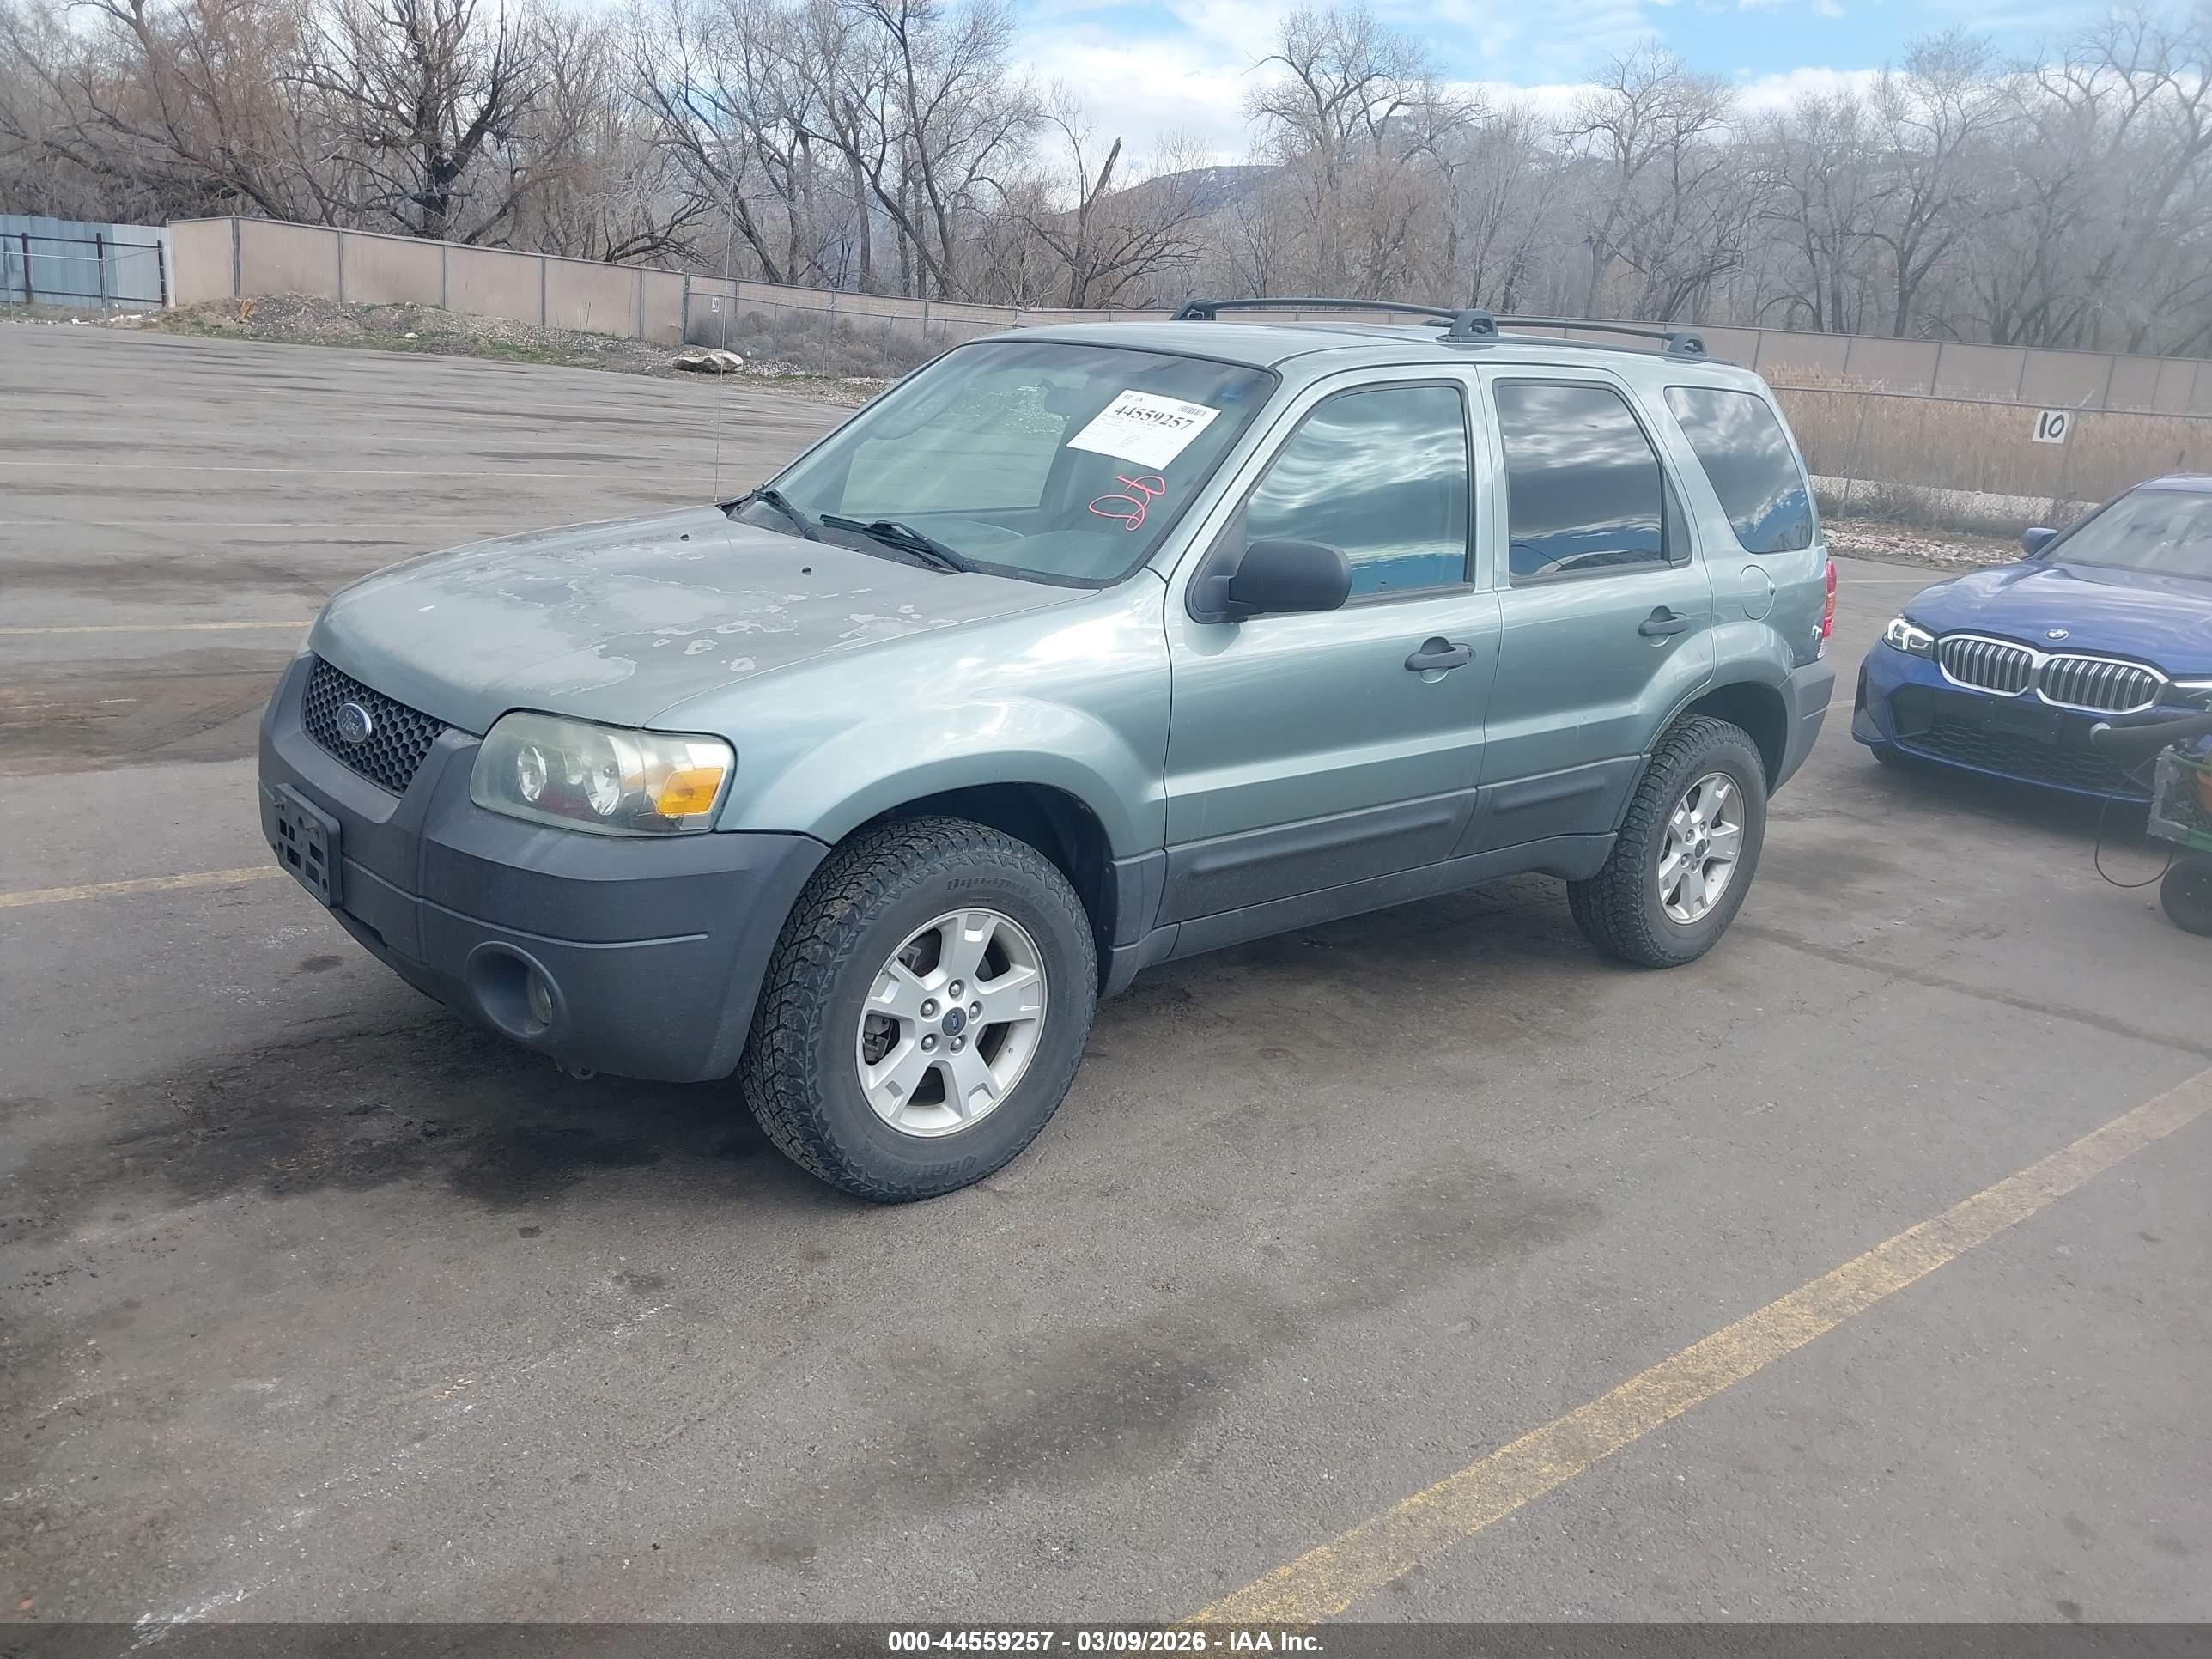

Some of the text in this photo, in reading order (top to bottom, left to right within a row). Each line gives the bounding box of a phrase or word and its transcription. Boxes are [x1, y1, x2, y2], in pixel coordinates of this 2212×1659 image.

[1115, 404, 1195, 431] 44559257
[2039, 412, 2065, 439] 10
[342, 709, 362, 736] Ford
